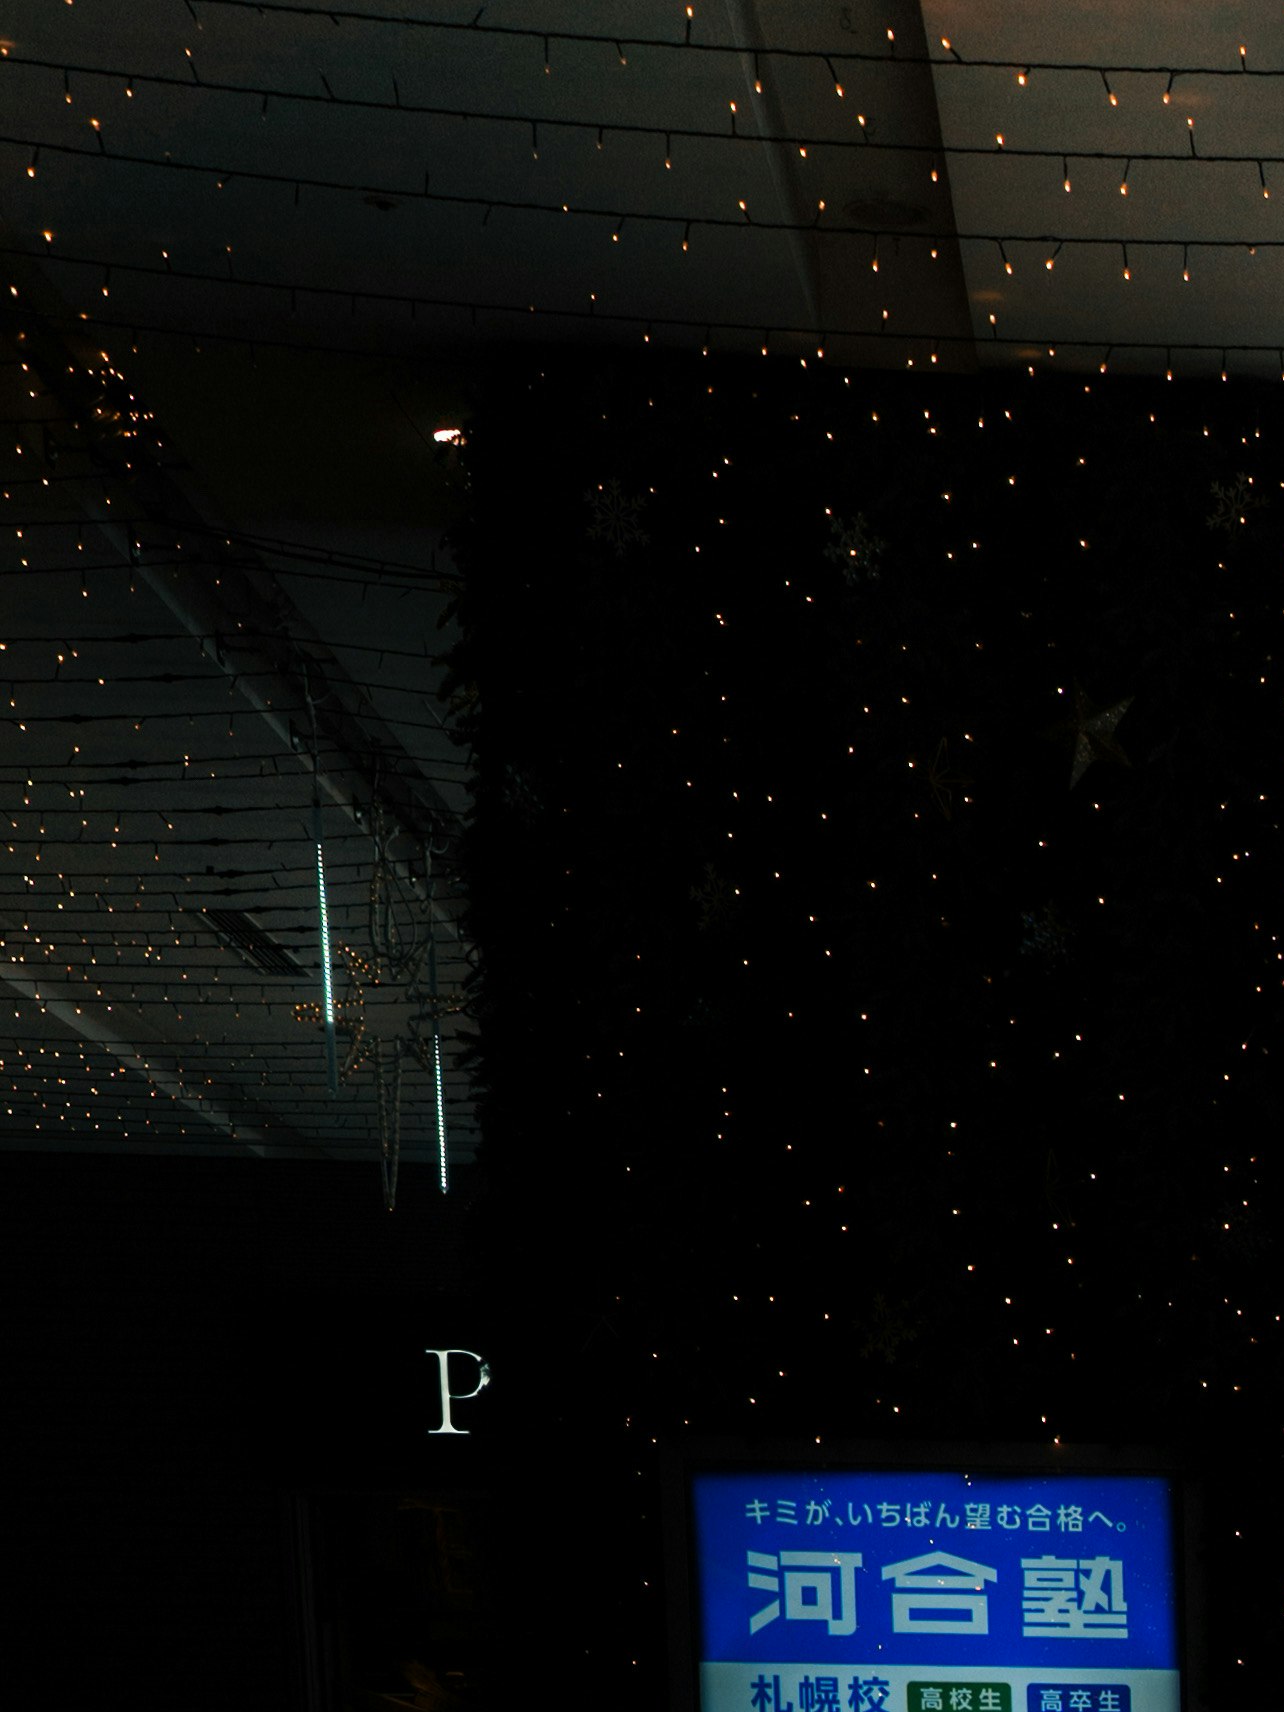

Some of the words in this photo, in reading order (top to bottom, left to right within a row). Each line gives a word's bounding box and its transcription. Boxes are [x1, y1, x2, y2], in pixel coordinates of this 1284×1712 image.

[425, 1349, 490, 1435] P
[745, 1498, 1127, 1533] キミが、いちばん望む合格へ。
[746, 1550, 1130, 1640] 河合塾
[919, 1687, 1003, 1712] 高校生
